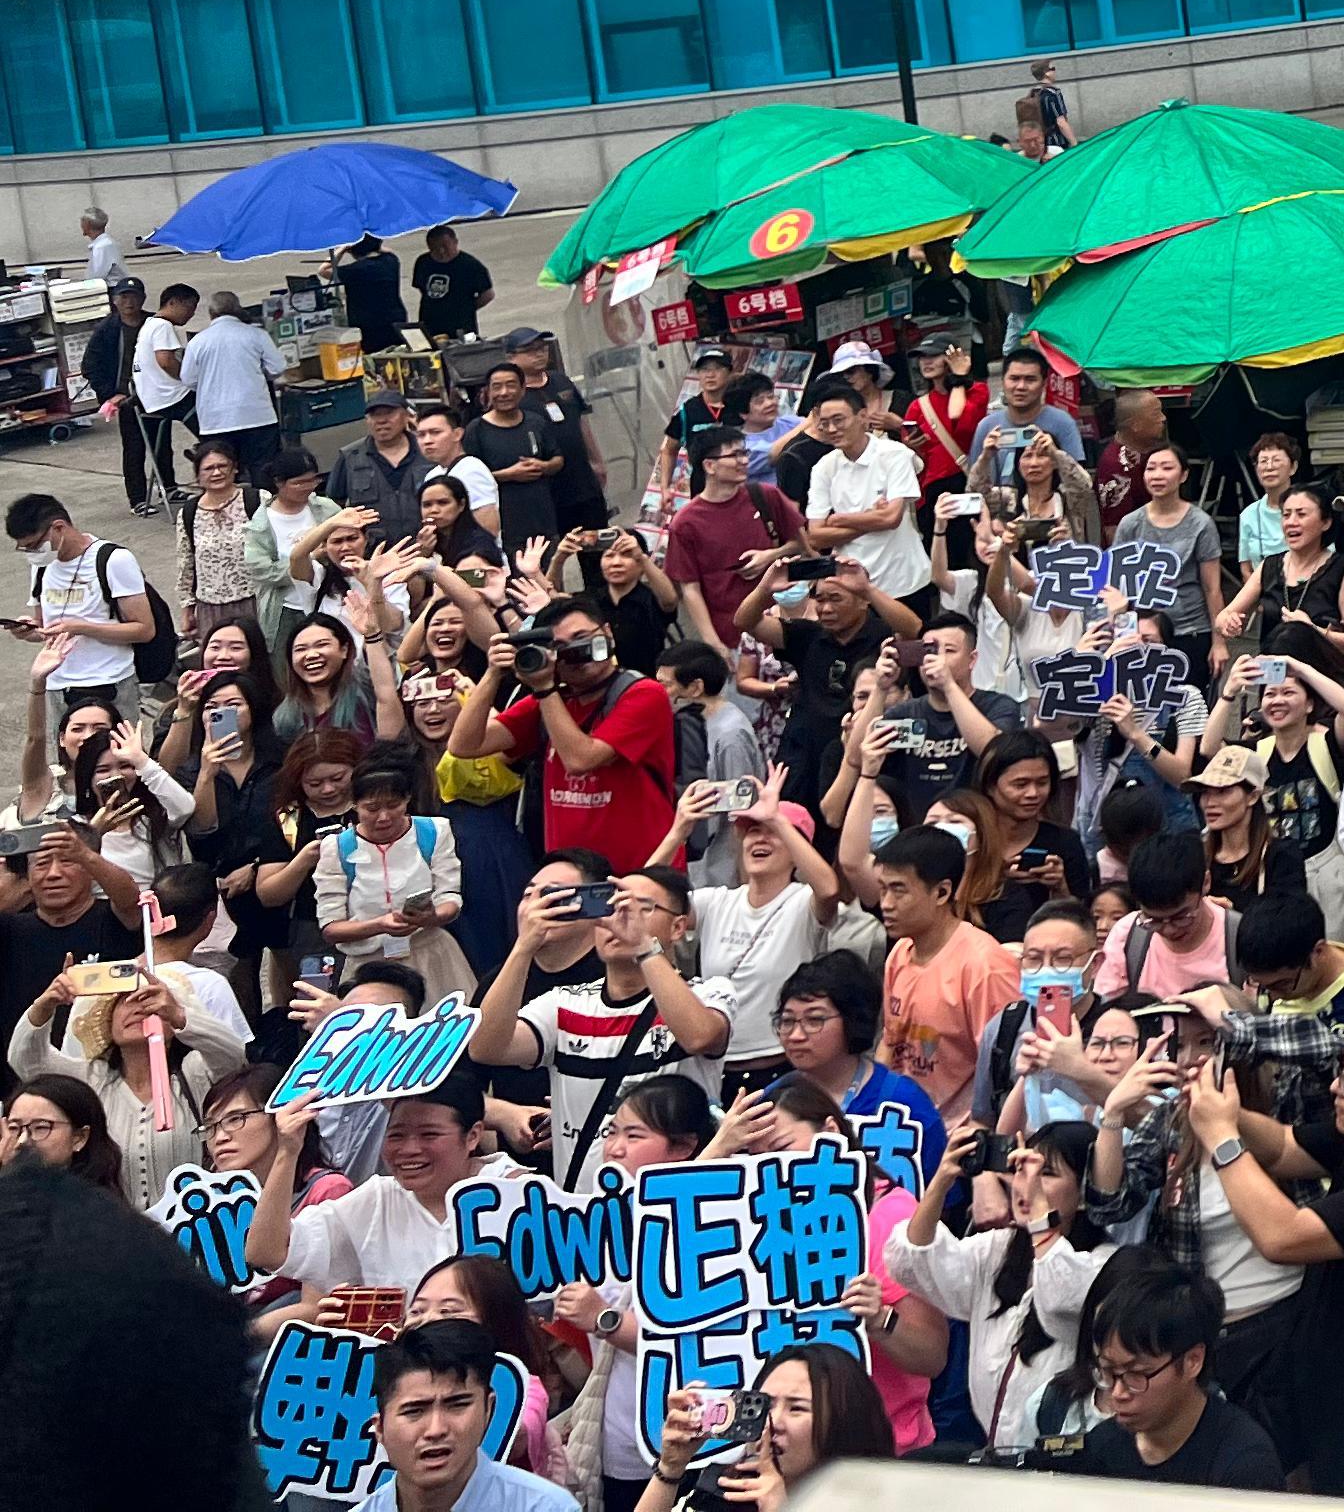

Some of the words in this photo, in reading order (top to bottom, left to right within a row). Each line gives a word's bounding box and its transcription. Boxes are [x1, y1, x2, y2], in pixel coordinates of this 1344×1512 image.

[766, 213, 799, 251] 6
[738, 289, 788, 314] 6号档
[1031, 540, 1182, 612] 定欣
[1033, 644, 1190, 720] 定欣
[269, 997, 476, 1110] Edwin
[453, 1169, 634, 1299] Edwi
[639, 1137, 867, 1330] 正楠
